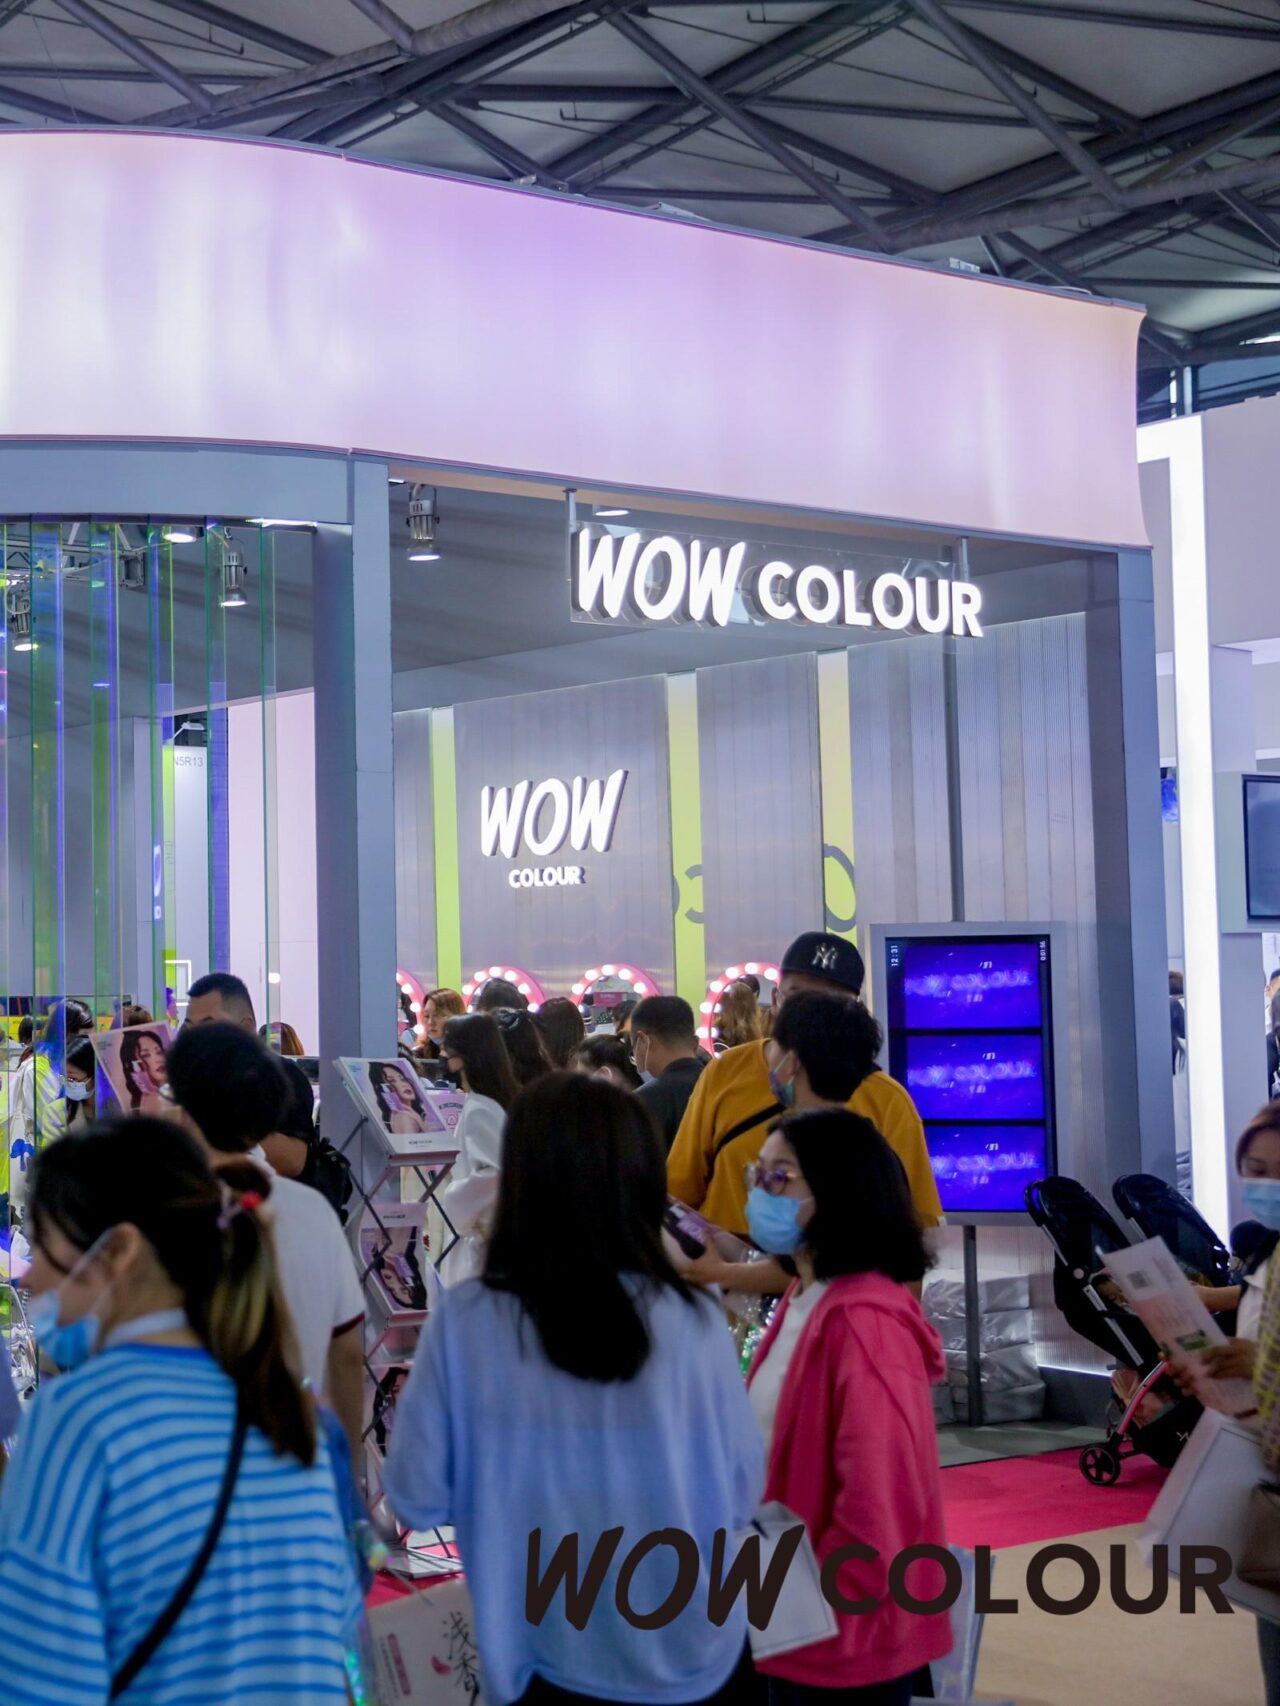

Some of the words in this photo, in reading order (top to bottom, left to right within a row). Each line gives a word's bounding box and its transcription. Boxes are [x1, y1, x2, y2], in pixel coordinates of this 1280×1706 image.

[578, 527, 747, 627] WOW
[758, 560, 984, 638] COLOUR
[481, 769, 625, 859] WOW
[508, 866, 583, 888] COLOUR
